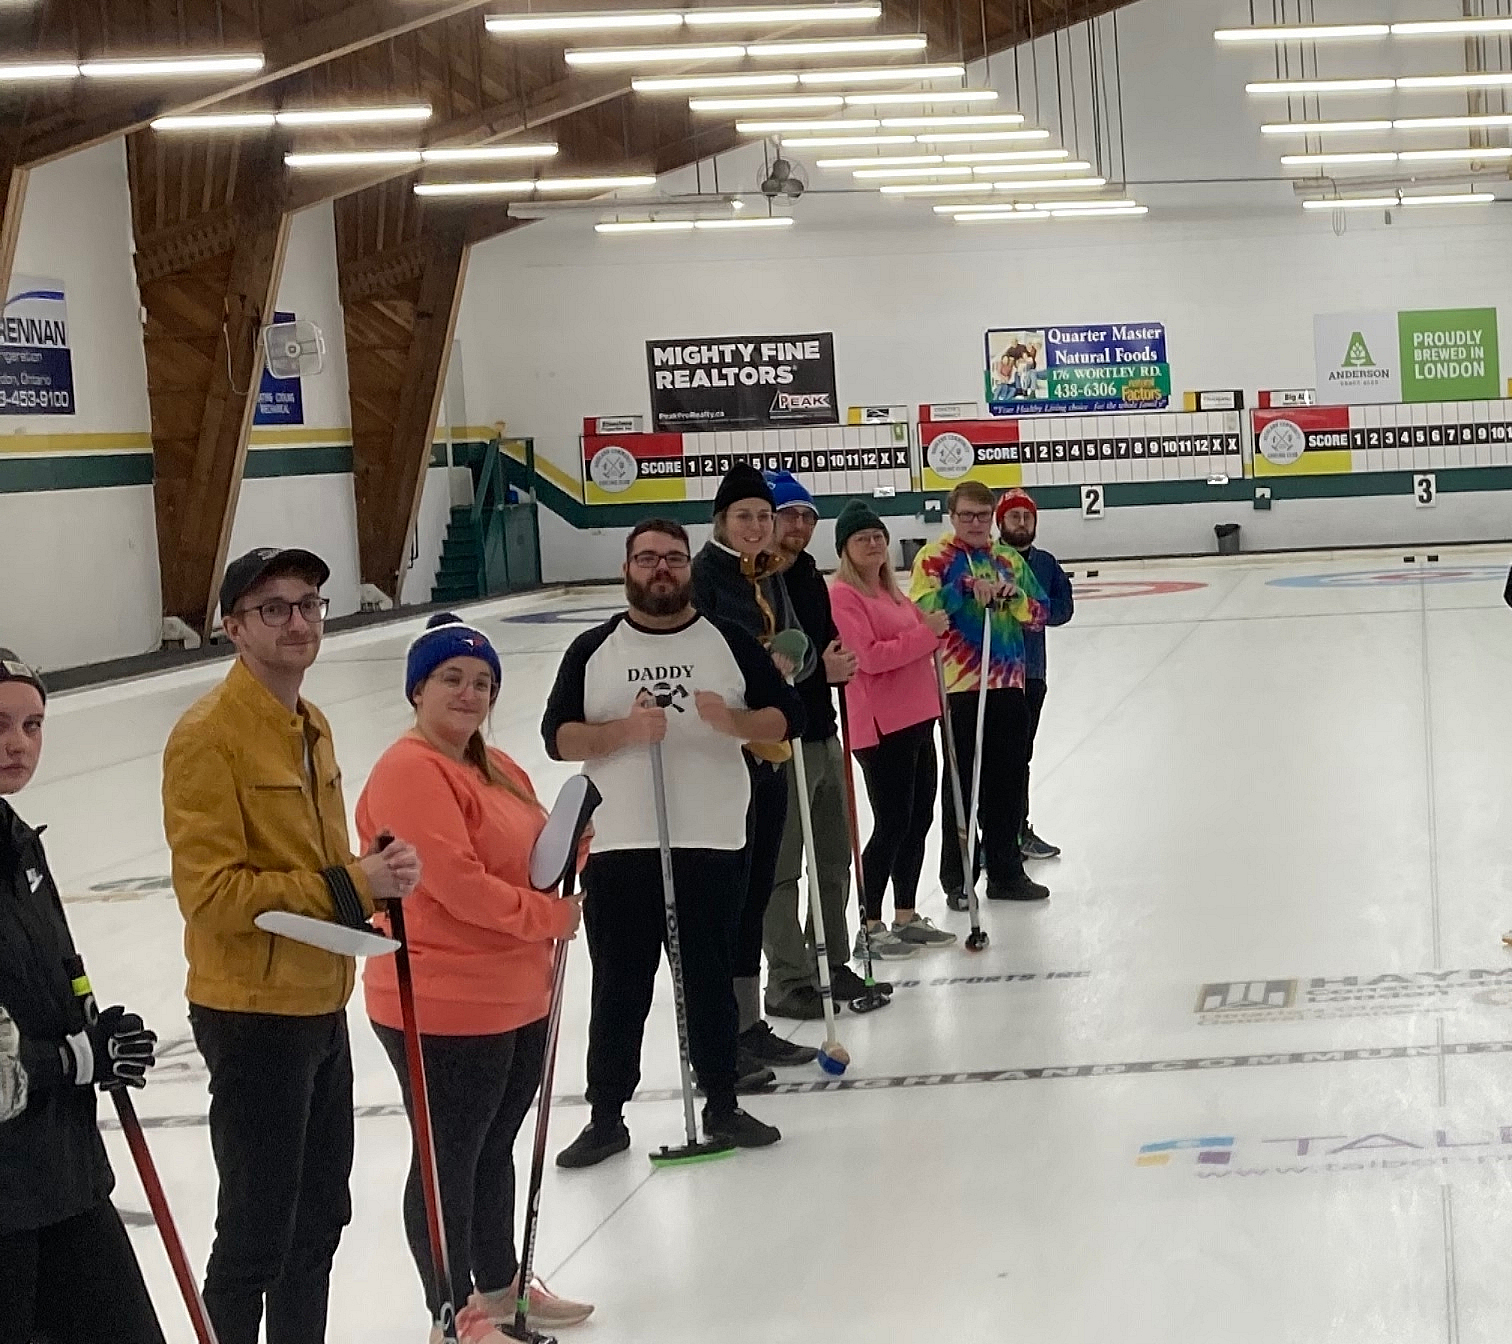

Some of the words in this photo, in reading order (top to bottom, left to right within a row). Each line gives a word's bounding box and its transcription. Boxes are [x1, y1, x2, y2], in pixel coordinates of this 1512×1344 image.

[1048, 328, 1107, 346] Quarter
[1112, 326, 1162, 341] Master
[1413, 329, 1484, 347] PROUDLY
[653, 343, 755, 366] MIGHTY
[760, 340, 821, 360] FINE
[1055, 348, 1110, 365] Natural
[1114, 346, 1158, 362] Foods
[1414, 348, 1467, 361] BREWED
[1470, 346, 1485, 359] IN
[1052, 369, 1070, 380] 176
[1074, 367, 1140, 378] WORTLEY
[1328, 368, 1390, 381] ANDERSON
[1415, 360, 1486, 380] LONDON
[1054, 382, 1117, 398] 438-6306
[1121, 386, 1162, 401] Factors
[1308, 434, 1348, 446] SCORE
[1354, 434, 1362, 444] 1
[1370, 433, 1378, 444] 2
[1385, 432, 1393, 444] 3
[1400, 432, 1410, 443] 4
[1416, 430, 1424, 442] 5
[1432, 430, 1440, 441] 6
[1447, 429, 1456, 440] 7
[1462, 428, 1471, 440] 8
[1478, 428, 1487, 439] 9
[1491, 427, 1504, 438] 10
[978, 448, 1018, 461] SCORE
[1024, 448, 1031, 458] 1
[1040, 446, 1048, 457] 2
[1055, 446, 1064, 457] 3
[1071, 445, 1080, 456] 4
[1087, 444, 1096, 456] 5
[1102, 444, 1111, 455] 6
[1118, 444, 1126, 454] 7
[1134, 442, 1143, 454] 8
[1150, 442, 1158, 453] 9
[1163, 441, 1176, 453] 10
[1179, 440, 1191, 452] 11
[1194, 440, 1208, 451] 12
[1212, 439, 1221, 450] X
[1228, 438, 1237, 450] X
[641, 462, 682, 474] SCORE
[688, 460, 696, 472] 1
[704, 460, 714, 472] 2
[720, 460, 729, 471] 3
[752, 459, 761, 470] 5
[769, 457, 777, 469] 6
[784, 457, 793, 468] 7
[800, 456, 809, 468] 8
[817, 455, 825, 467] 9
[830, 454, 844, 466] 10
[846, 454, 859, 466] 11
[862, 454, 876, 465] 12
[880, 453, 890, 464] X
[896, 452, 906, 464] X
[1418, 478, 1432, 504] 3
[1085, 489, 1100, 515] 2
[628, 664, 694, 682] DADDY
[776, 1062, 1126, 1094] HIGHLAND
